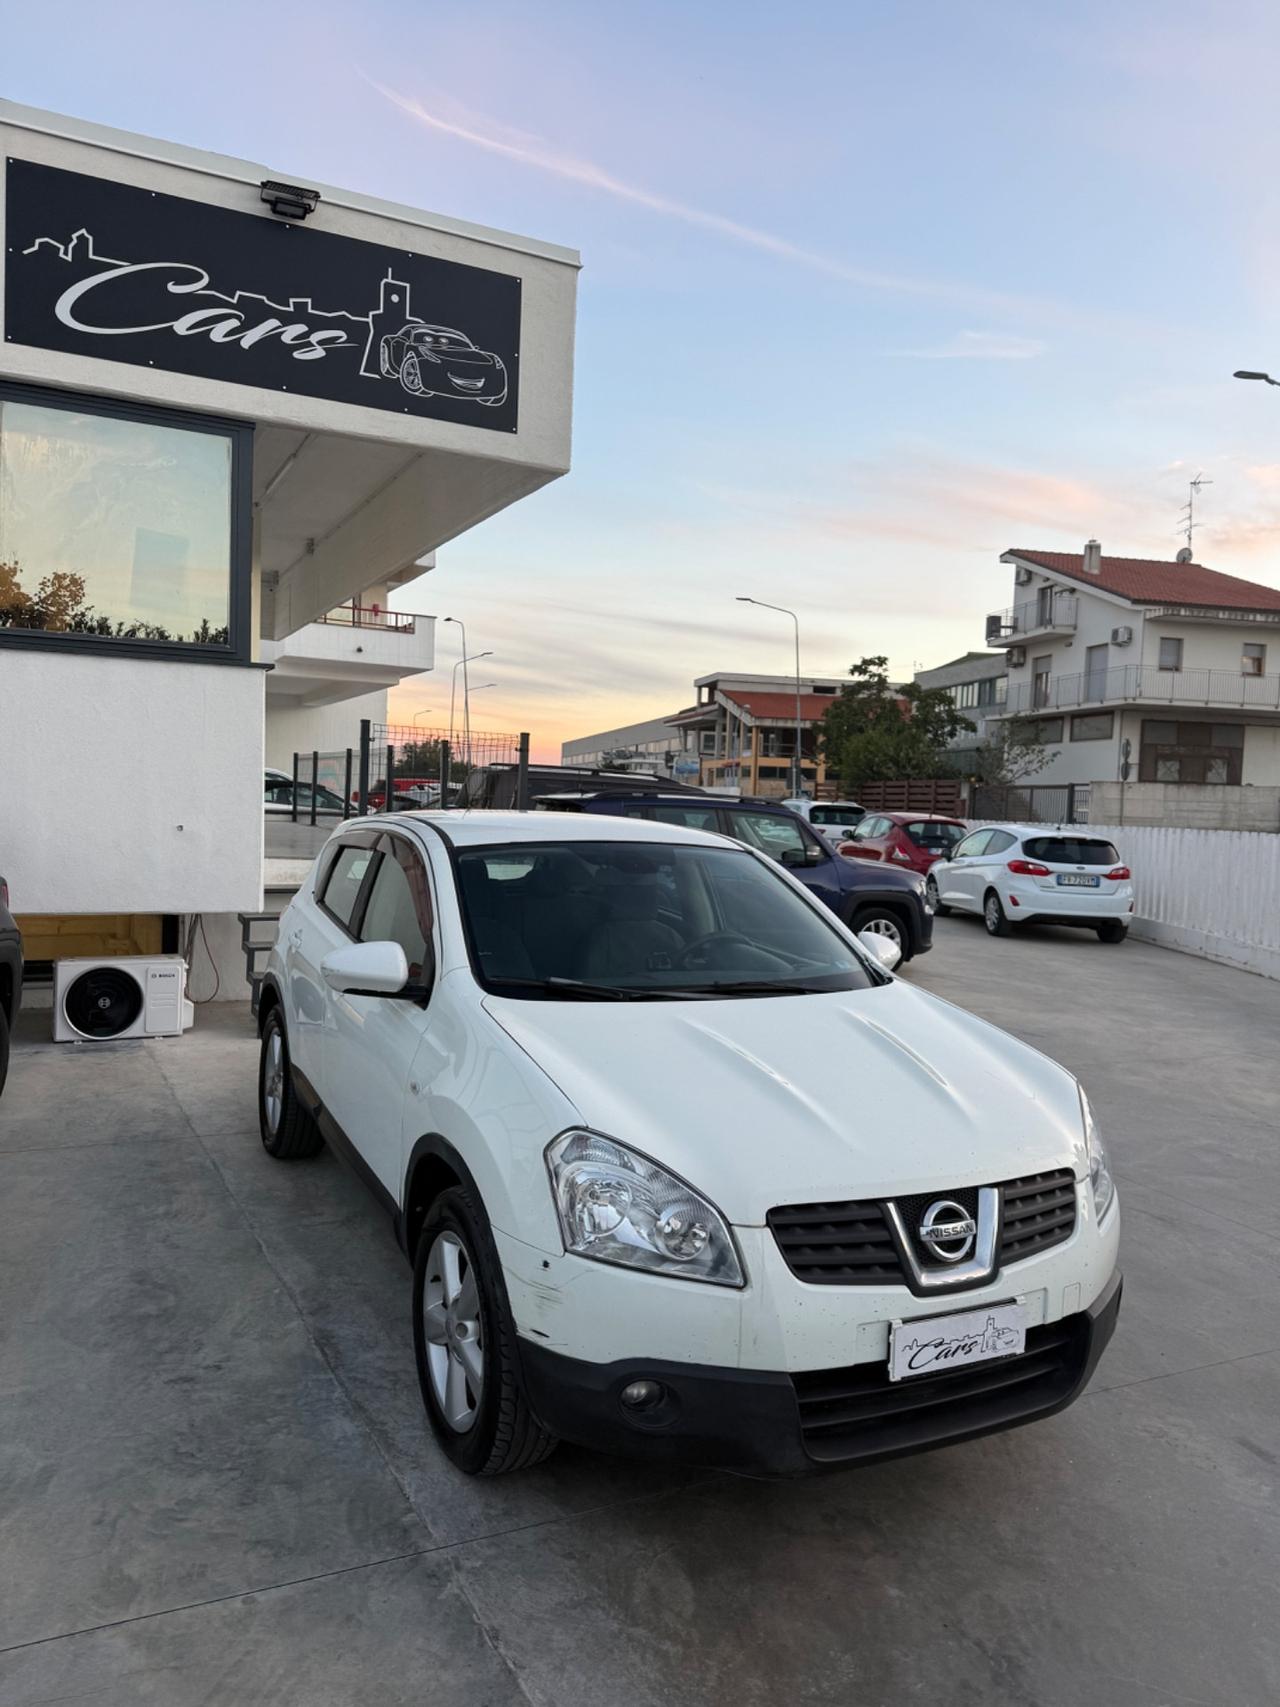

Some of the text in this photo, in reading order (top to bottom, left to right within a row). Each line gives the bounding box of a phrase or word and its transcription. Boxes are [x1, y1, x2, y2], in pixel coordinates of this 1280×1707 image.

[55, 261, 360, 361] Cars
[928, 1224, 973, 1238] NISSAN
[908, 1338, 978, 1370] Cars
